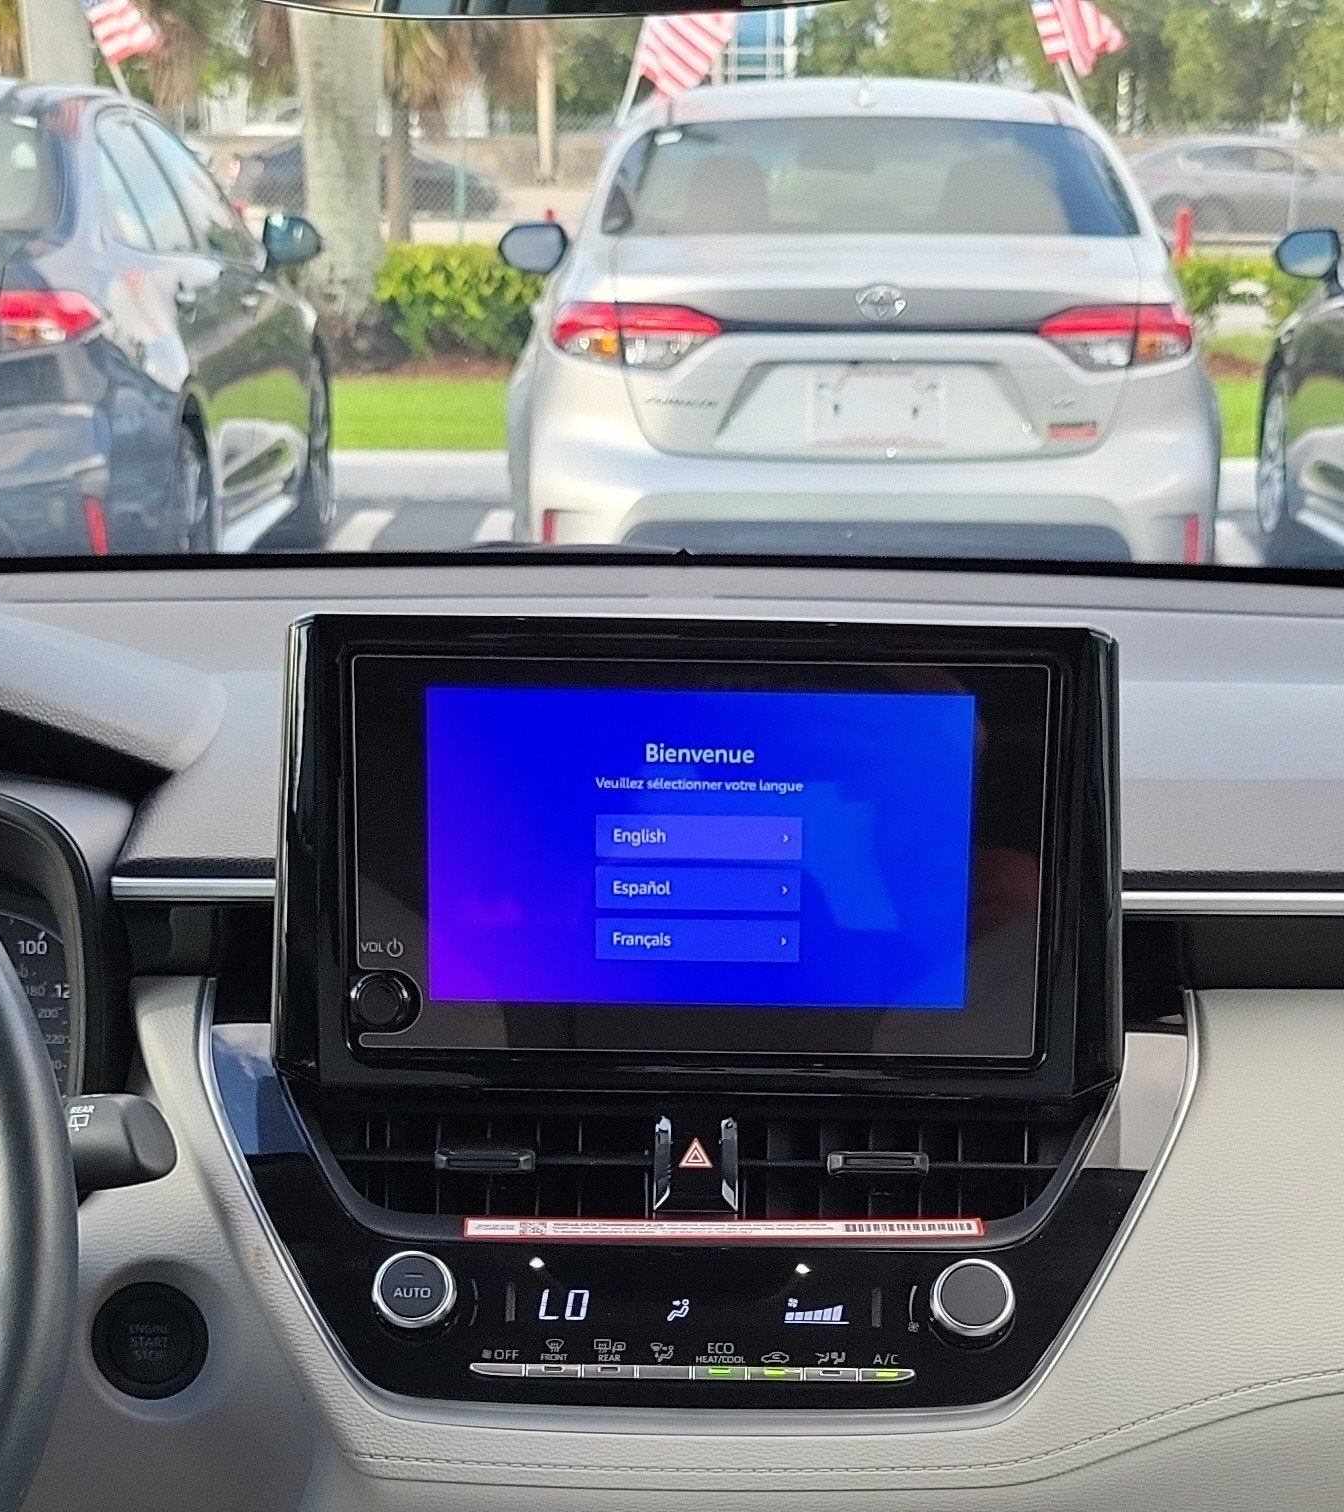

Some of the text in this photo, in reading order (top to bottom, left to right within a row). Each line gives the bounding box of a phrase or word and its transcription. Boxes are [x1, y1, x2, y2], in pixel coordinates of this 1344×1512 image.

[645, 743, 755, 764] Bienvenue
[595, 777, 805, 795] Veuillez sélectionner votre langue
[613, 828, 667, 847] English
[613, 880, 671, 897] Español
[613, 931, 672, 950] Français
[17, 940, 48, 955] 100
[360, 941, 385, 953] VOL
[55, 984, 70, 999] 12
[70, 1105, 95, 1114] REAR
[394, 1287, 431, 1298] AUTO
[707, 1342, 735, 1354] ECO
[494, 1349, 520, 1360] OFF
[540, 1353, 568, 1362] FRONT
[598, 1354, 622, 1362] REAR
[695, 1355, 746, 1364] HEAT/COOL
[873, 1353, 899, 1365] A/C
